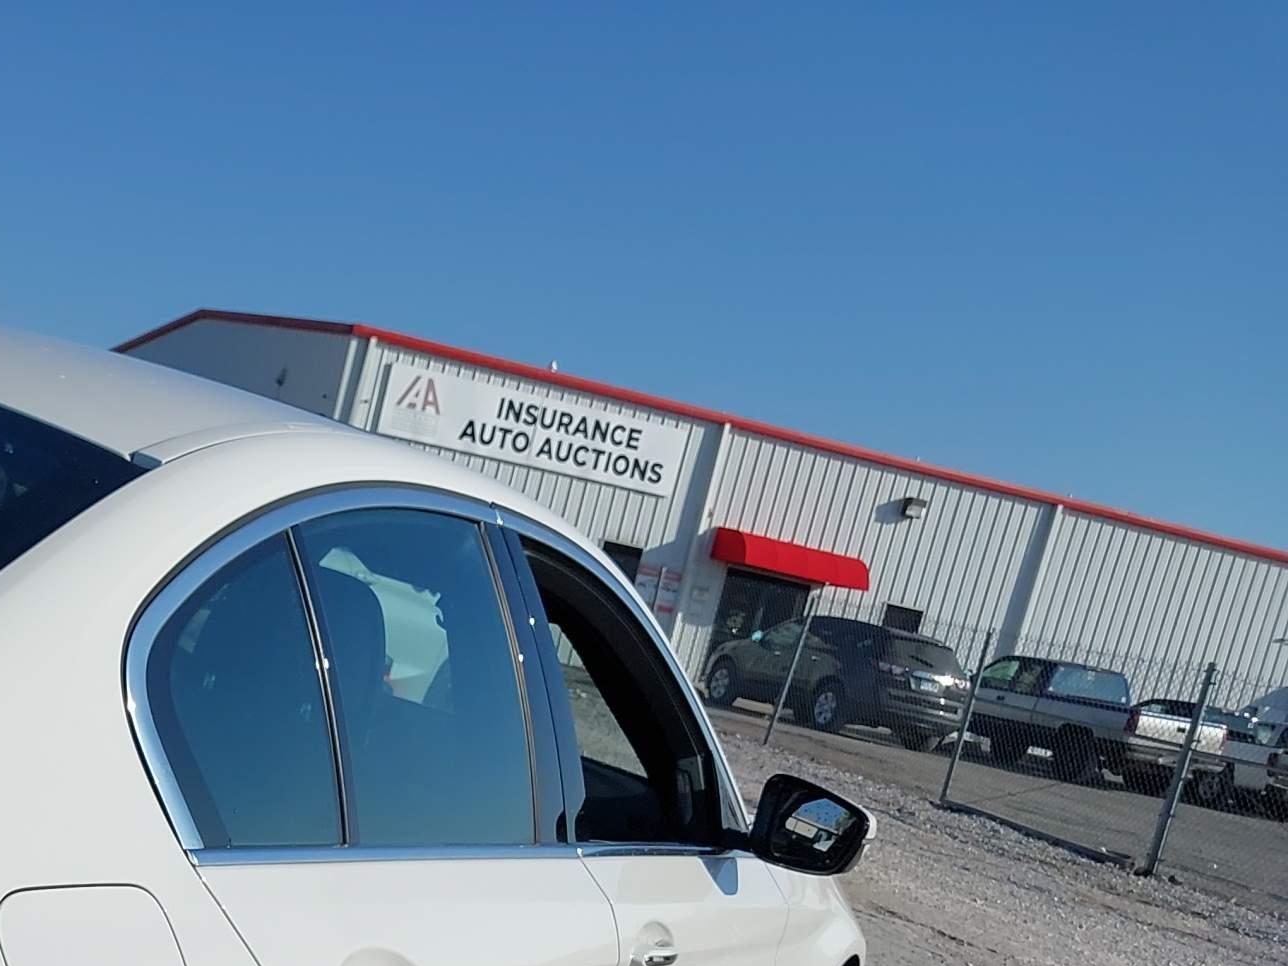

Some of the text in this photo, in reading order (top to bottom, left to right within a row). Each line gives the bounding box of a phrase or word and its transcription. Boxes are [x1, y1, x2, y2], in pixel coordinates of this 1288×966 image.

[459, 419, 664, 484] AUTO AUCTIONS
[497, 397, 643, 450] INSURANCE
